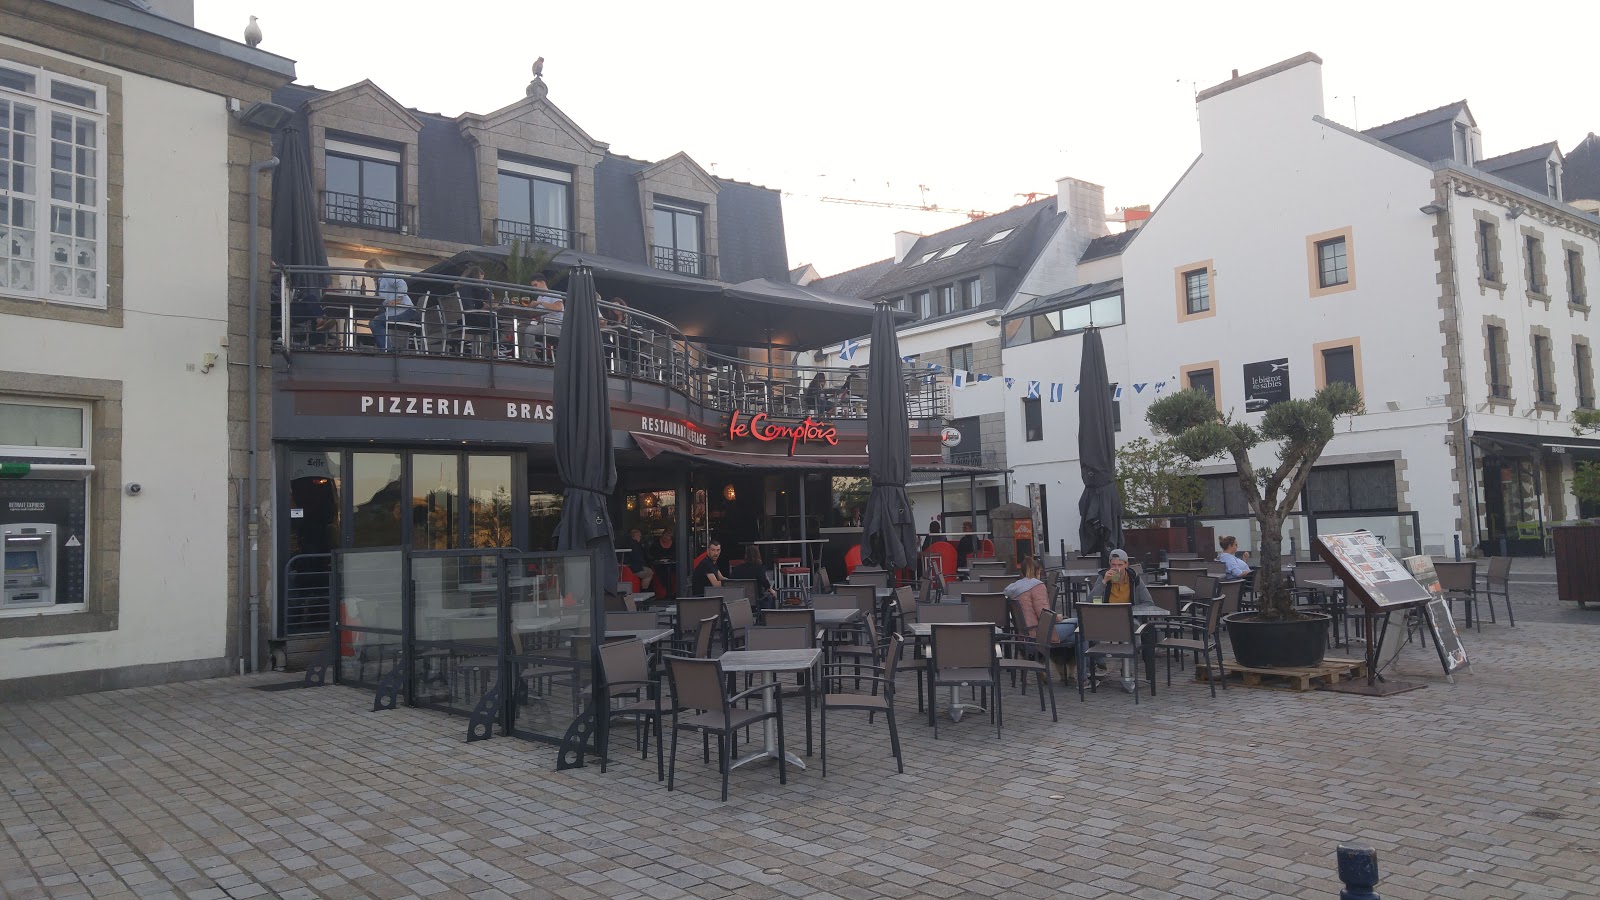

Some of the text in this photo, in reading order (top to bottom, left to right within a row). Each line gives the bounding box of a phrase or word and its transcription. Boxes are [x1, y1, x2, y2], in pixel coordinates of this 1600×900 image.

[361, 396, 475, 416] PIZZERIA
[641, 416, 686, 438] RESTAURANT
[750, 412, 839, 456] Comptoir
